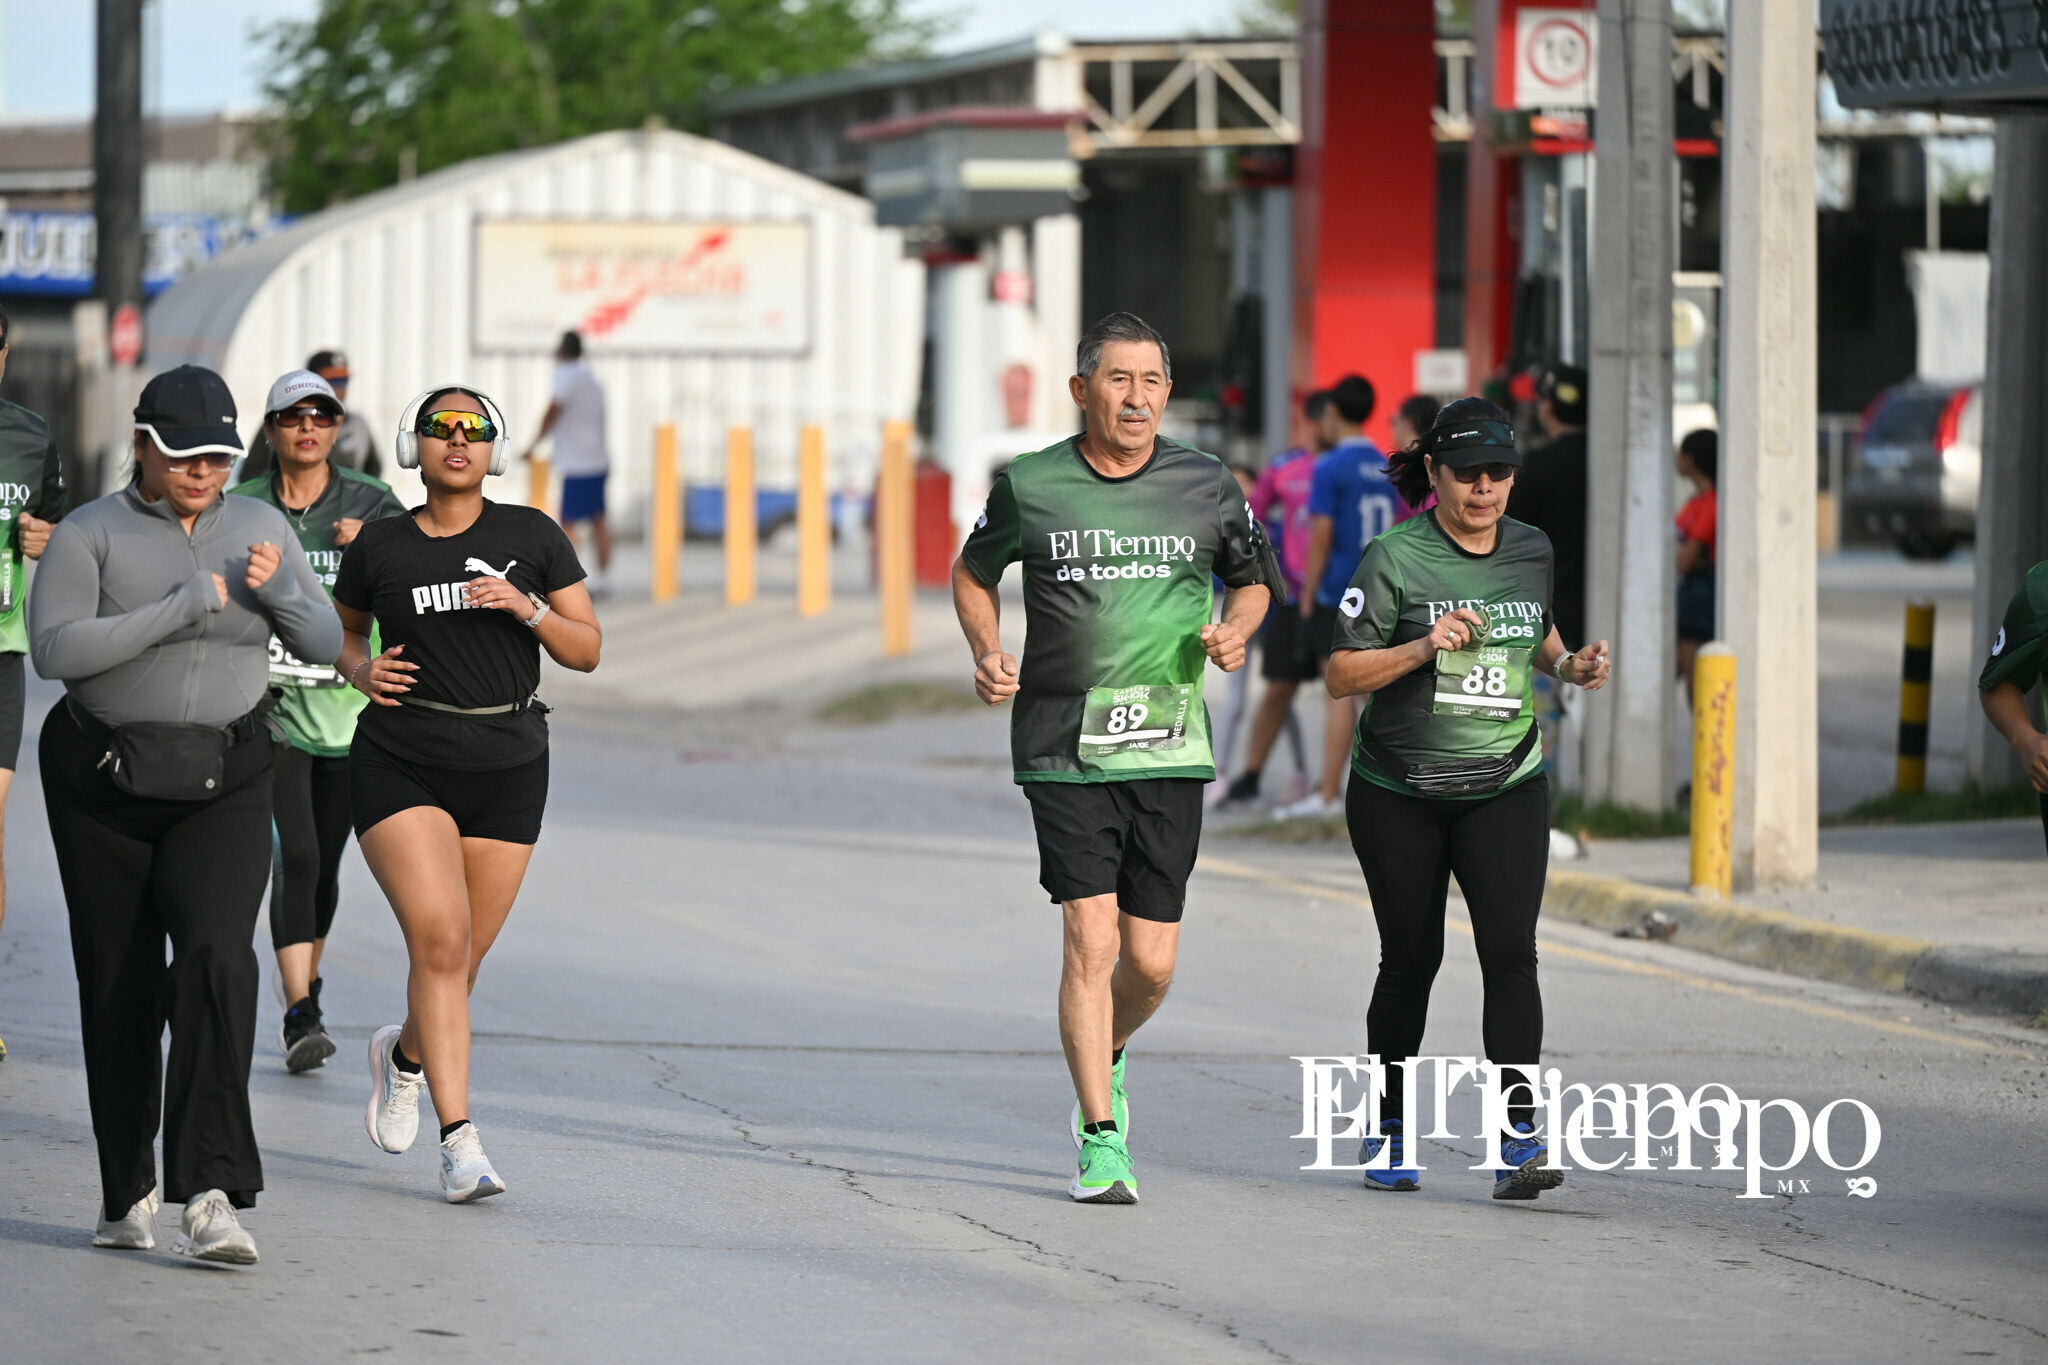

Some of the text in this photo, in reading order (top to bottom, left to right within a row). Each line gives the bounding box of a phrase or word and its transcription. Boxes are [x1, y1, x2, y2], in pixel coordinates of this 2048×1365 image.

[1047, 529, 1196, 562] El Tiempo
[3, 562, 11, 605] MEDALLA
[1056, 561, 1172, 581] de todos
[412, 581, 491, 614] PUM
[1491, 623, 1535, 639] dos
[1462, 665, 1507, 696] 88
[1107, 703, 1149, 734] 89
[1171, 699, 1189, 740] MEDALLA
